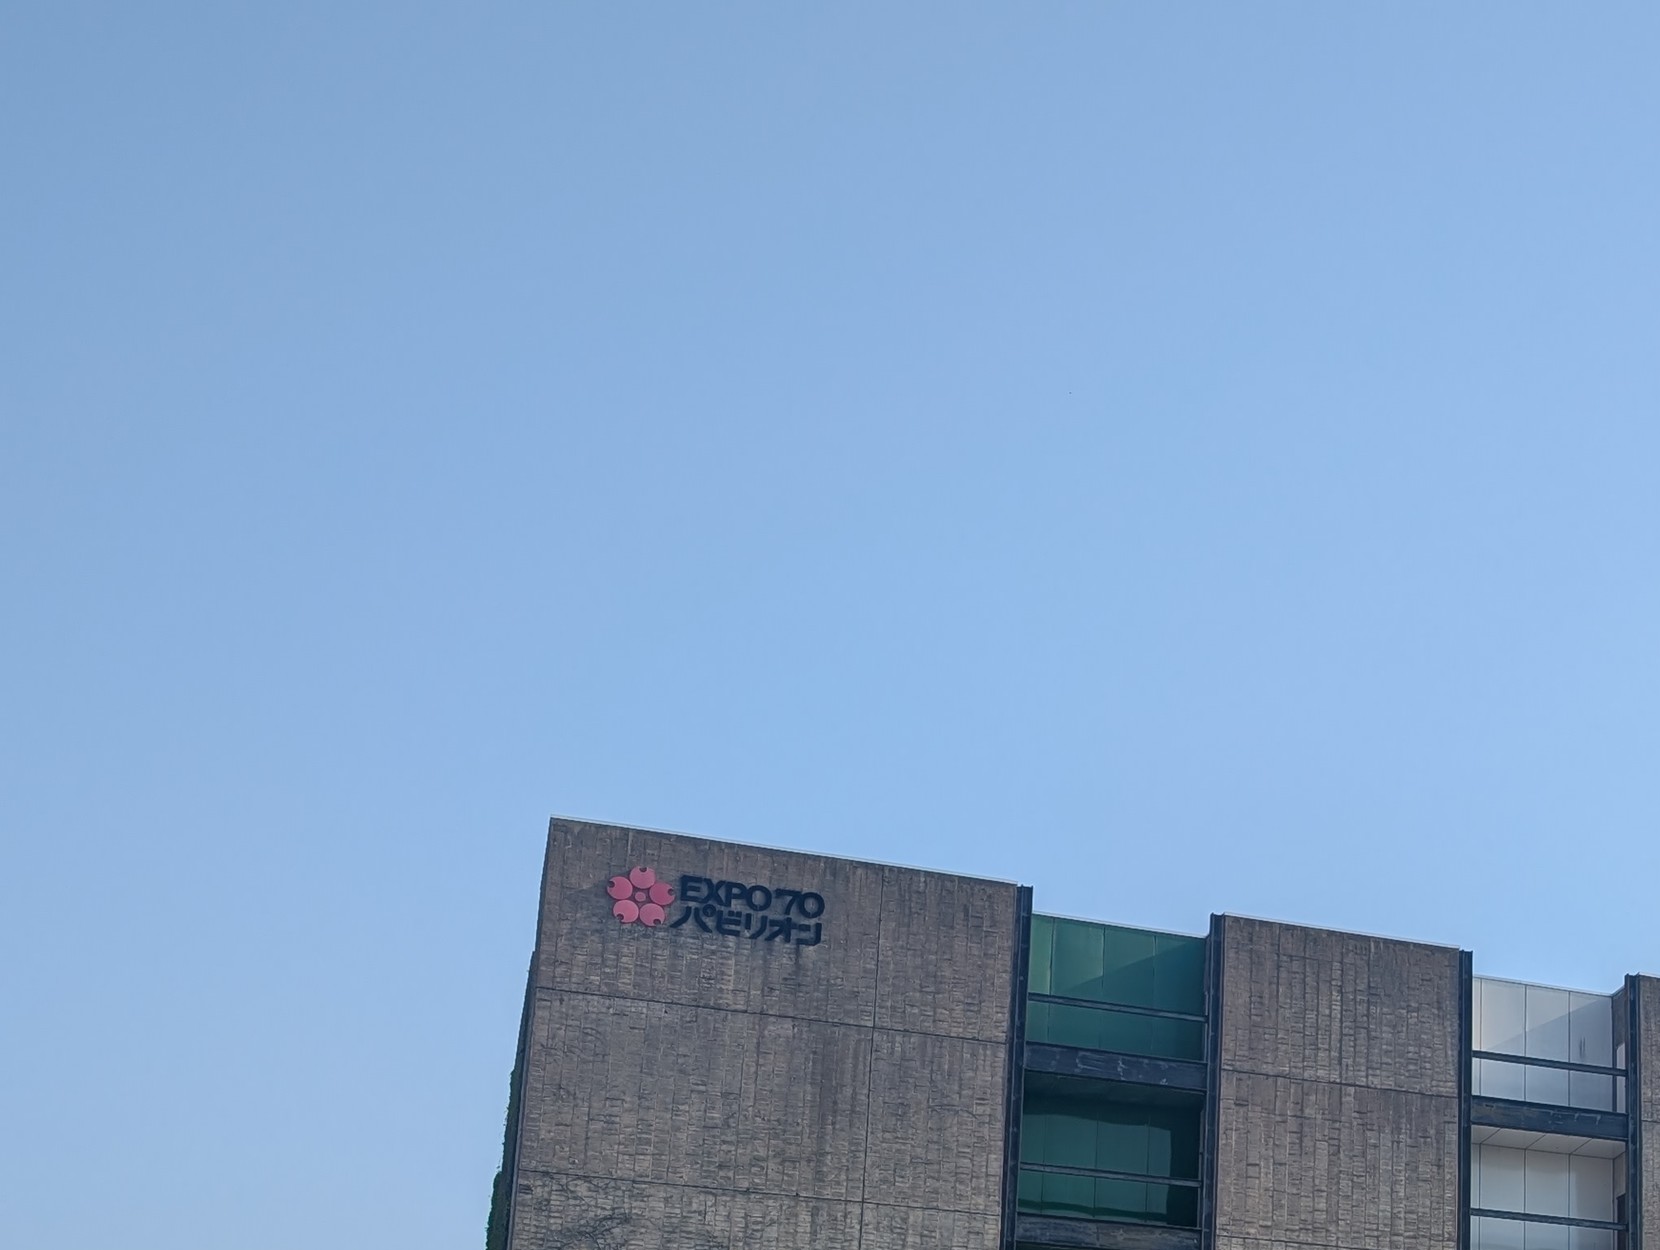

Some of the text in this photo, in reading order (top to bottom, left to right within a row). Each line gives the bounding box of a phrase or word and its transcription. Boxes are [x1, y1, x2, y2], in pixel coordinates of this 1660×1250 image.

[670, 904, 822, 946] パビリオン
